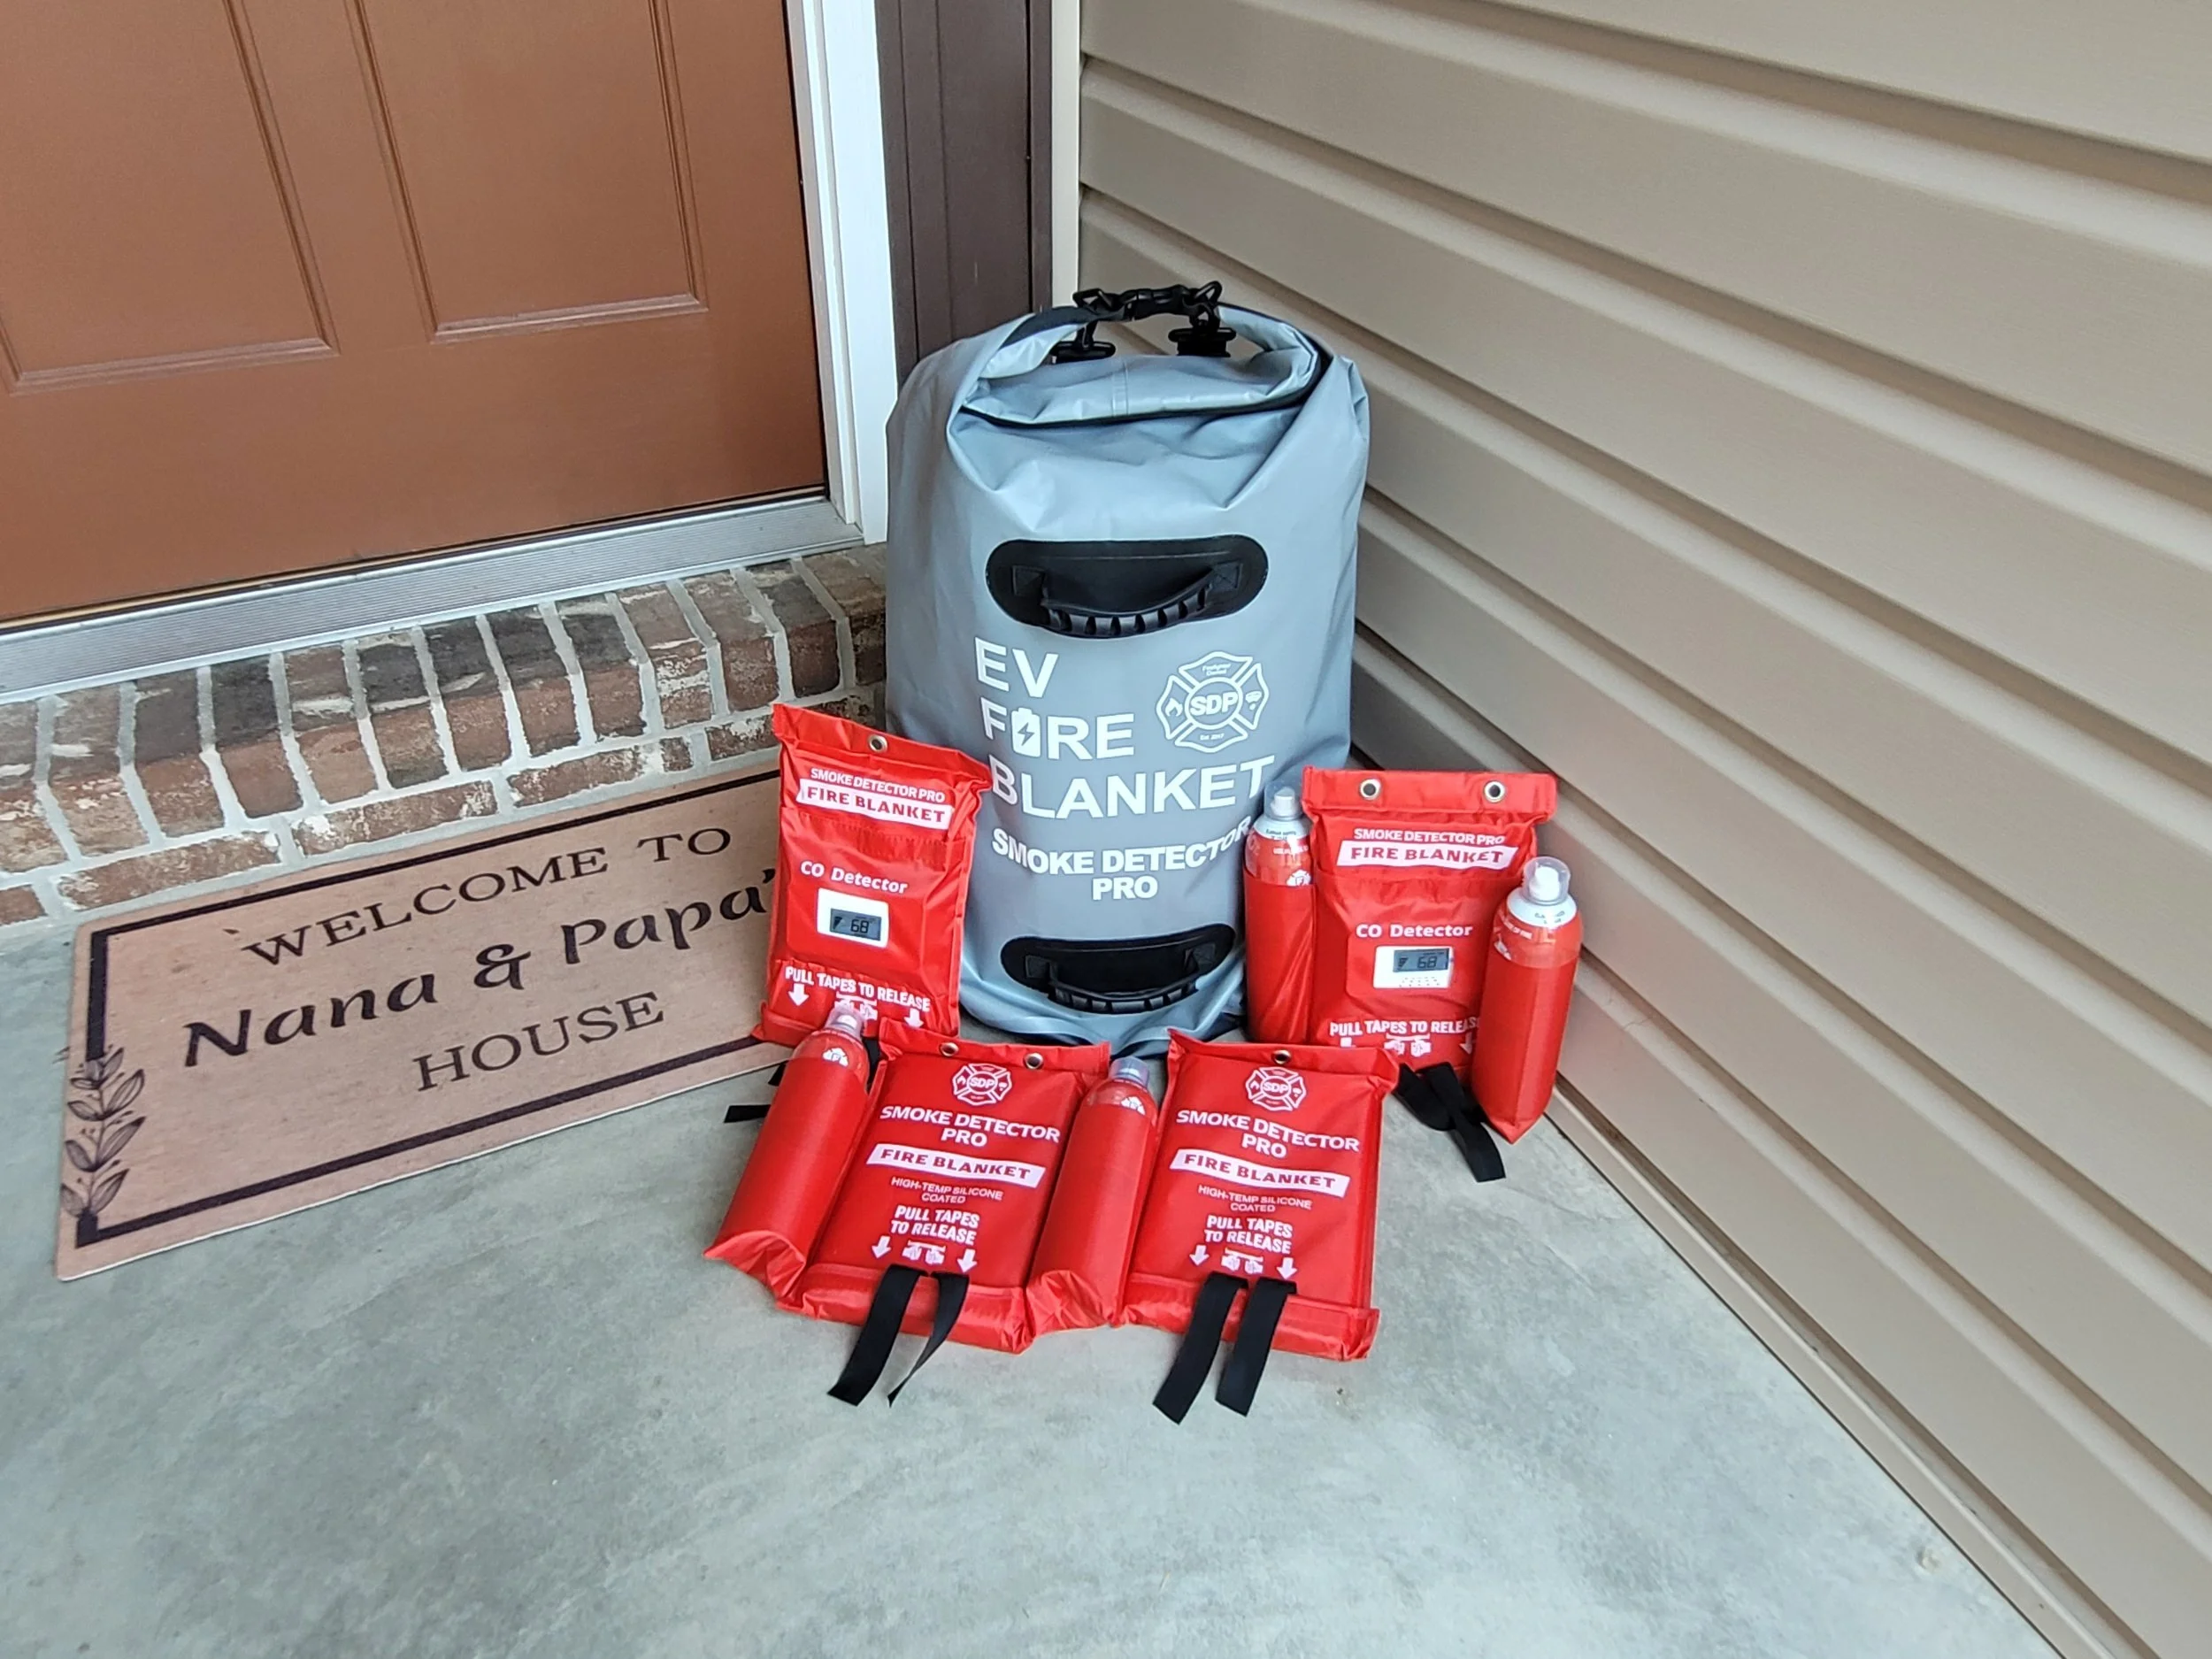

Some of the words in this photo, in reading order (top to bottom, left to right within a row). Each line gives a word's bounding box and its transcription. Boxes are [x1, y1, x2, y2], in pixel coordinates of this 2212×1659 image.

[975, 637, 1058, 697] EV
[1190, 691, 1239, 716] SDP
[811, 767, 854, 786] SMOKE
[854, 776, 917, 798] DETECTOR
[918, 788, 946, 803] PRO
[988, 755, 1275, 819] BLANKET
[807, 786, 850, 805] FIRE
[855, 795, 945, 823] BLANKET
[992, 827, 1094, 874] SMOKE
[1102, 816, 1251, 873] DETECTOR
[1354, 828, 1402, 841] SMOKE
[1403, 830, 1475, 844] DETECTOR
[1476, 833, 1506, 845] PRO
[1351, 847, 1399, 860] FIRE
[1404, 849, 1504, 864] BLANKET
[800, 860, 826, 879] CO
[831, 866, 909, 895] Detector
[1092, 875, 1158, 900] PRO
[242, 847, 610, 967] WELCOME
[637, 826, 733, 863] TO
[850, 918, 870, 934] 68
[1356, 924, 1382, 938] CO
[1390, 923, 1473, 938] Detector
[1417, 956, 1438, 969] 68
[785, 965, 814, 986] PULL
[817, 972, 856, 994] TAPES
[857, 981, 875, 998] TO
[877, 987, 931, 1012] RELEASE
[184, 972, 437, 1068] Nana
[472, 942, 533, 991] &
[1329, 1021, 1363, 1036] PULL
[1364, 1019, 1407, 1034] TAPES
[1409, 1020, 1428, 1033] TO
[413, 991, 666, 1092] HOUSE
[969, 1077, 995, 1089] SDP
[1263, 1081, 1289, 1094] SDP
[879, 1105, 952, 1125] SMOKE
[954, 1112, 1061, 1143] DETECTOR
[1176, 1110, 1250, 1131] SMOKE
[1252, 1118, 1360, 1152] DETECTOR
[941, 1127, 987, 1148] PRO
[1241, 1133, 1287, 1158] PRO
[880, 1148, 927, 1166] FIRE
[933, 1156, 1031, 1180] BLANKET
[1184, 1153, 1232, 1174] FIRE
[1237, 1161, 1336, 1189] BLANKET
[891, 1176, 951, 1195] HIGH-TEMP
[952, 1186, 1004, 1201] SILICONE
[921, 1193, 966, 1204] COATED
[1198, 1184, 1259, 1204] HIGH-TEMP
[1260, 1194, 1312, 1210] SILICONE
[895, 1204, 930, 1222] PULL
[934, 1209, 980, 1228] TAPES
[1230, 1201, 1276, 1213] COATED
[891, 1219, 910, 1235] TO
[911, 1222, 977, 1246] RELEASE
[1206, 1214, 1242, 1231] PULL
[1247, 1217, 1294, 1239] TAPES
[1203, 1228, 1224, 1243] TO
[1226, 1230, 1293, 1255] RELEASE
